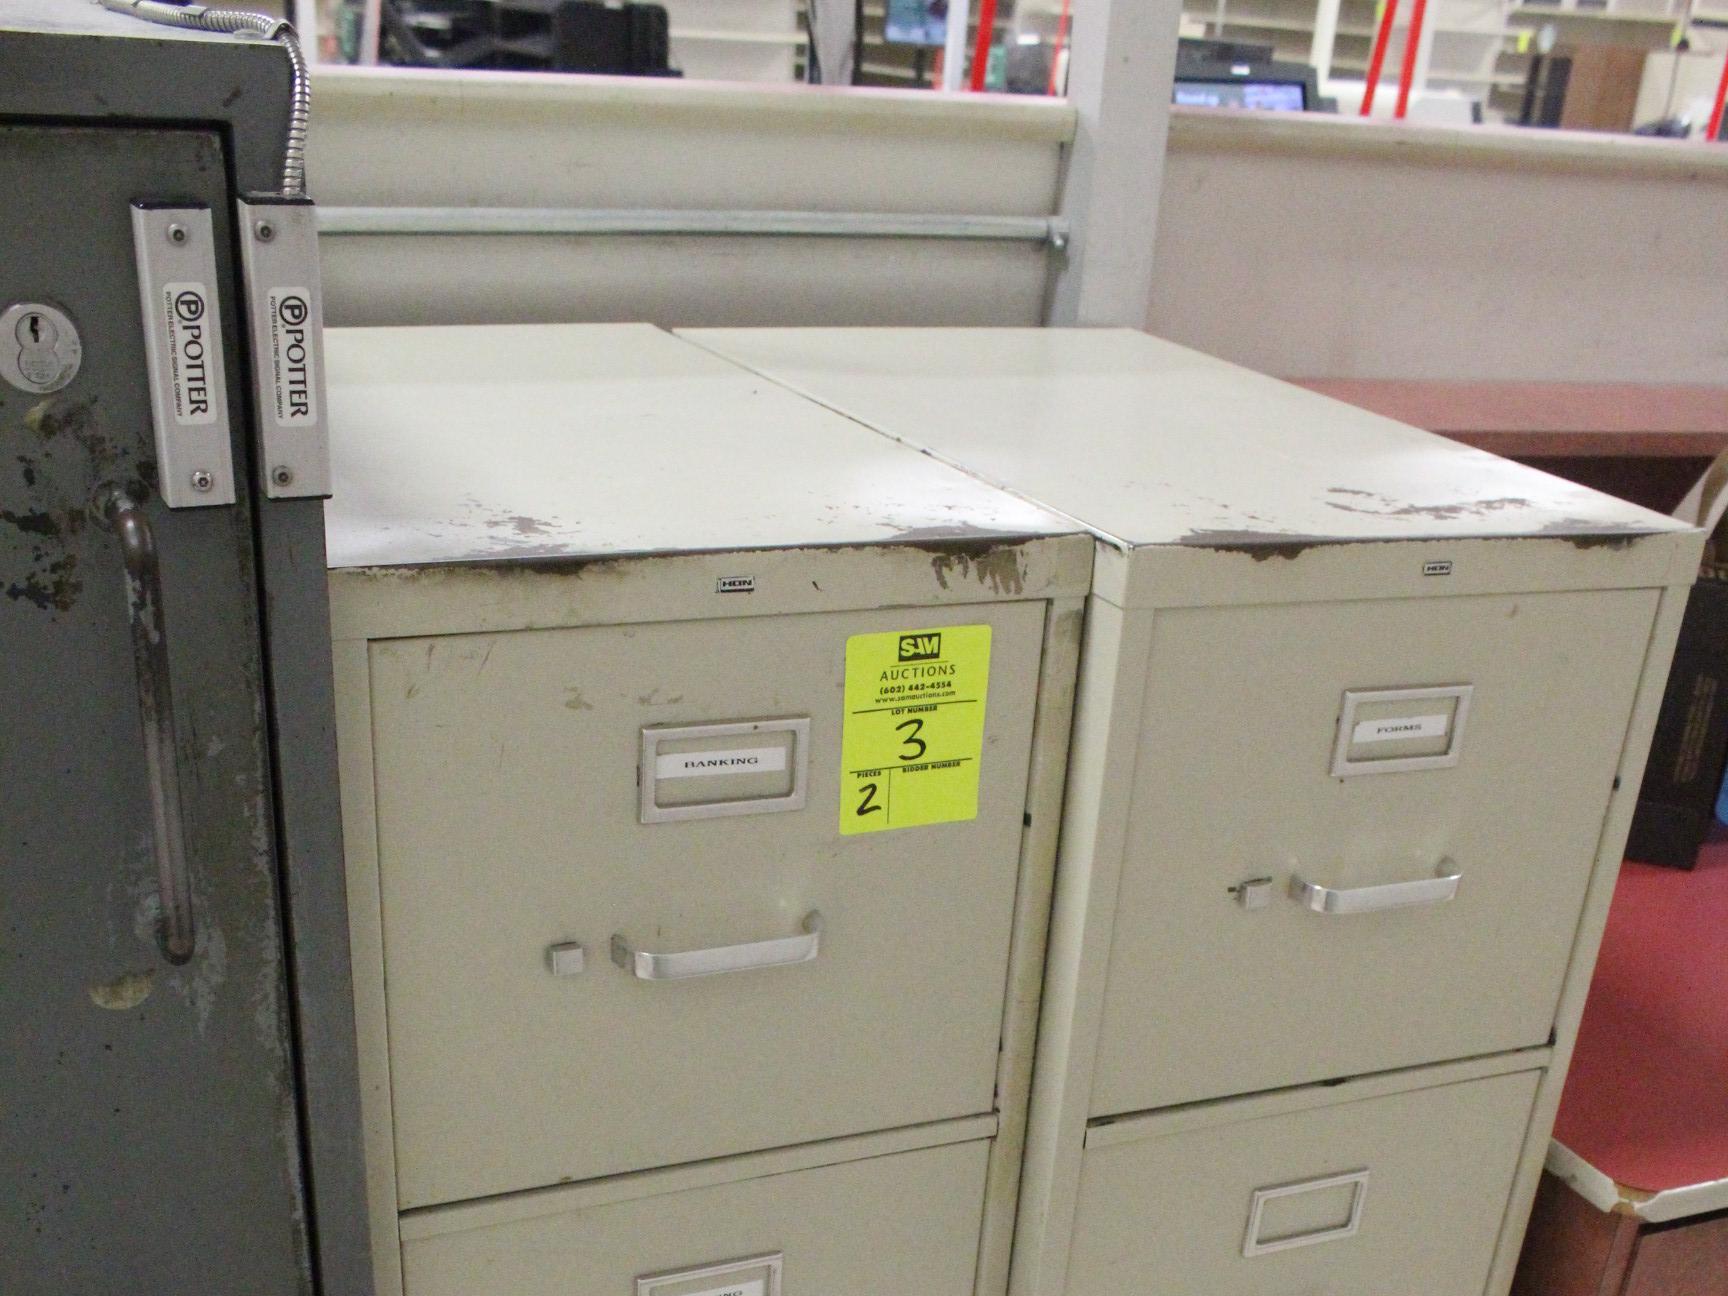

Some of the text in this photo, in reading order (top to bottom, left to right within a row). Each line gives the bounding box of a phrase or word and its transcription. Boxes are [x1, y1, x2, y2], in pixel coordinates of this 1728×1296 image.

[166, 291, 183, 417] POTTER ELECTRIC SIGNAL COMPANY
[269, 296, 284, 419] POTTER ELECTRIC SIGNAL COMPANY
[182, 325, 209, 416] POTTER
[286, 329, 309, 418] POTTER
[880, 664, 956, 682] AUCTIONS
[880, 681, 952, 695] (602) 442-4554
[875, 690, 956, 703] www.samauctions.com
[891, 704, 938, 716] LOT NUMBER
[1376, 723, 1422, 734] FORMS
[895, 718, 927, 761] 3
[684, 757, 758, 768] BANKING
[902, 760, 961, 773] BIDDER NUMBER
[856, 771, 882, 779] PIECES
[856, 783, 882, 817] 2
